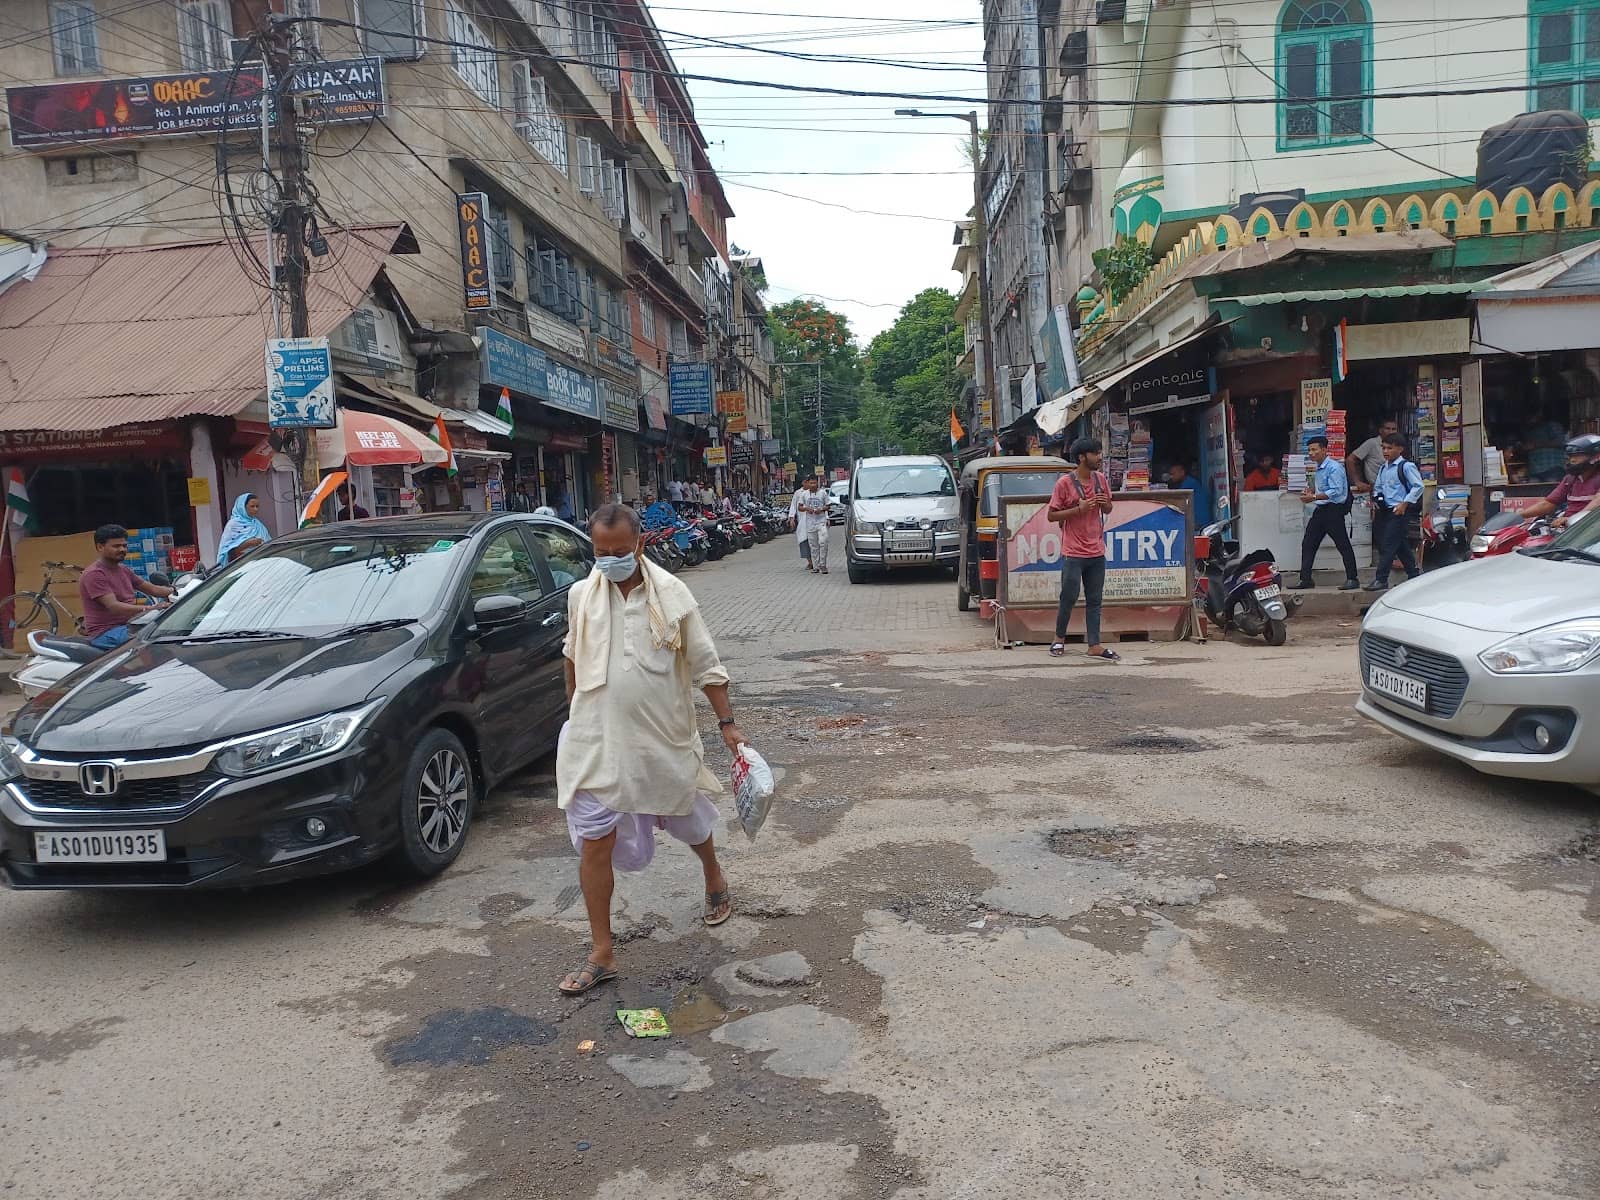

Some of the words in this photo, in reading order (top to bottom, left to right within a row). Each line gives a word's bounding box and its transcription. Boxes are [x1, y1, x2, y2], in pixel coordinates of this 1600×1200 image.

[283, 364, 326, 373] PRELIMS
[300, 357, 325, 366] APSC
[547, 372, 570, 397] BOOK
[571, 381, 592, 403] LAND
[1132, 369, 1204, 393] pentonic
[1304, 388, 1329, 408] 50%
[1016, 534, 1062, 565] NO
[1104, 530, 1179, 562] NTRY
[1374, 671, 1425, 703] AS01DX1545
[50, 835, 157, 856] AS01DU1935
